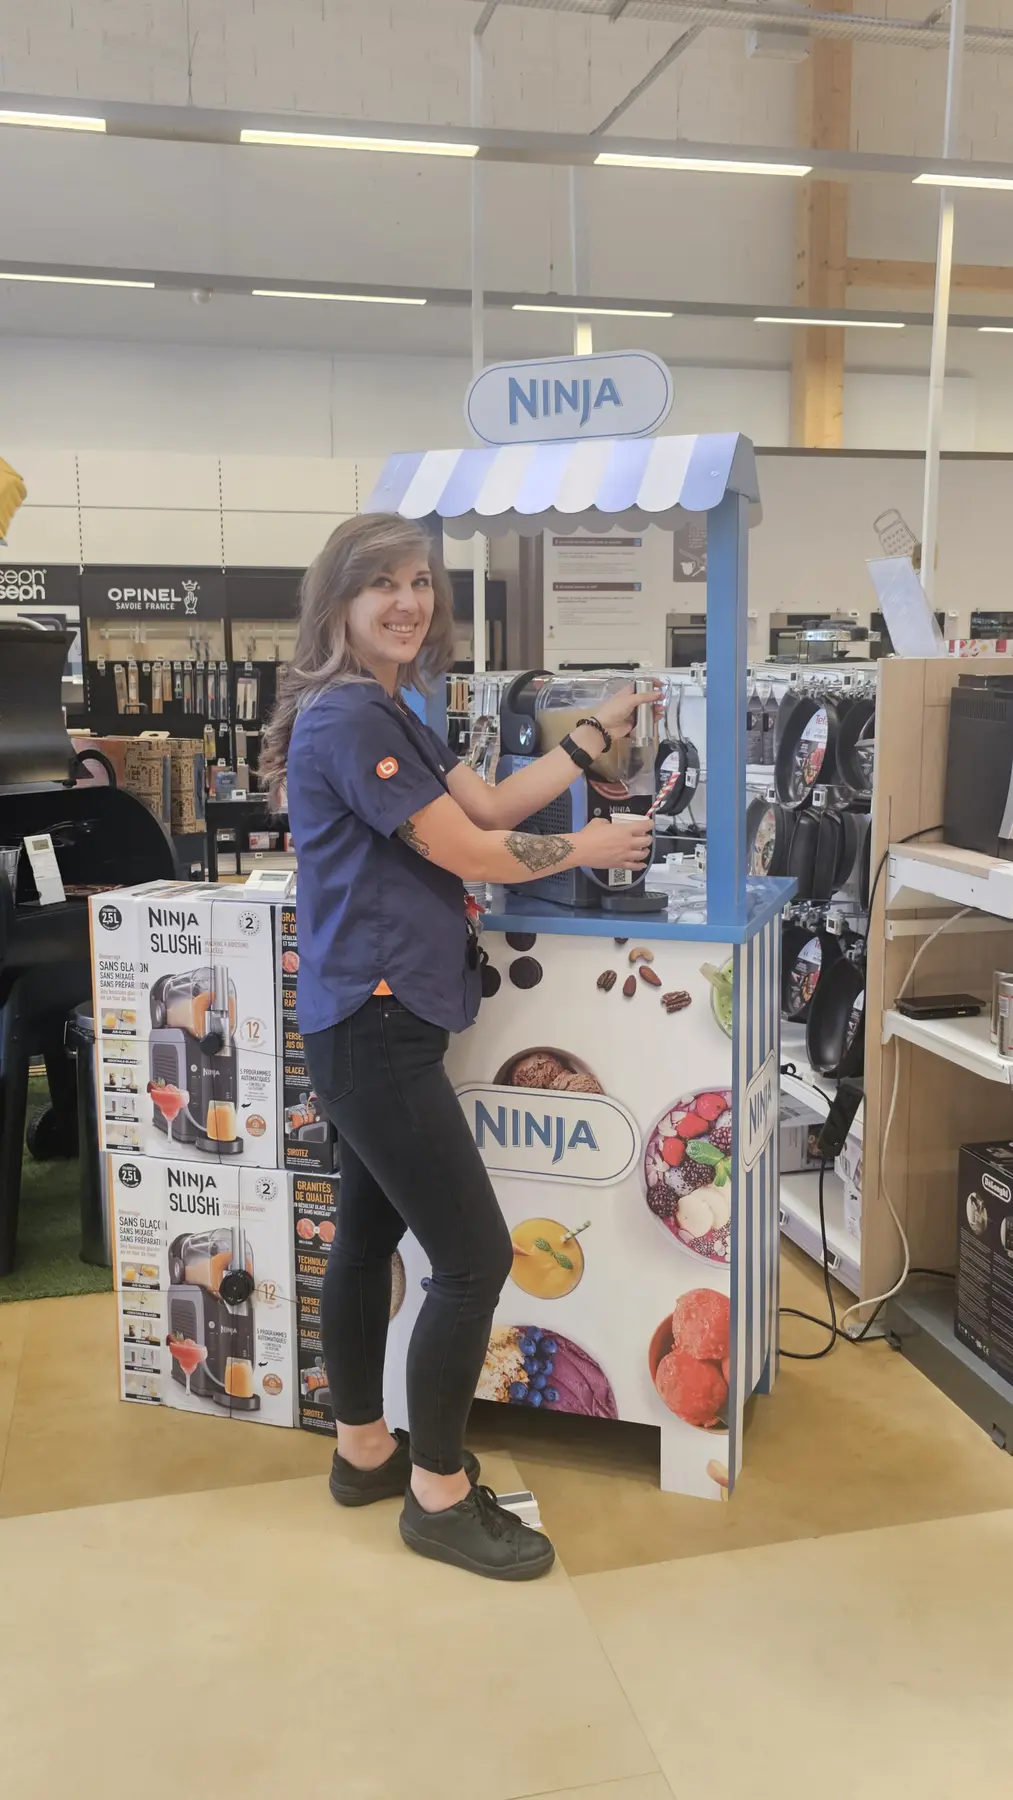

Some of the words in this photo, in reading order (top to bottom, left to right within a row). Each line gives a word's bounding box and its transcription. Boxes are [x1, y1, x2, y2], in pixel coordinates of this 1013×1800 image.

[508, 377, 624, 428] NINJA
[107, 588, 182, 602] OPINEL
[102, 912, 119, 925] 2,5L
[148, 906, 199, 933] NINJA
[246, 917, 253, 929] 2
[151, 933, 202, 956] SLUSHi
[99, 961, 119, 972] SANS
[100, 971, 114, 980] SANS
[115, 973, 135, 981] MIXAGE
[100, 980, 114, 988] SANS
[246, 1021, 259, 1038] 12
[203, 1067, 220, 1080] NINJA
[475, 1100, 600, 1165] NINJA
[121, 1170, 139, 1183] 2,5L
[167, 1167, 217, 1193] NINJA
[263, 1183, 270, 1195] 2
[297, 1181, 332, 1194] GRANITÉS
[169, 1193, 220, 1216] SLUSHi
[306, 1193, 334, 1205] QUALITÉ
[119, 1216, 138, 1227] SANS
[120, 1227, 133, 1235] SANS
[120, 1235, 133, 1243] SANS
[263, 1283, 276, 1299] 12
[221, 1325, 238, 1336] NINJA
